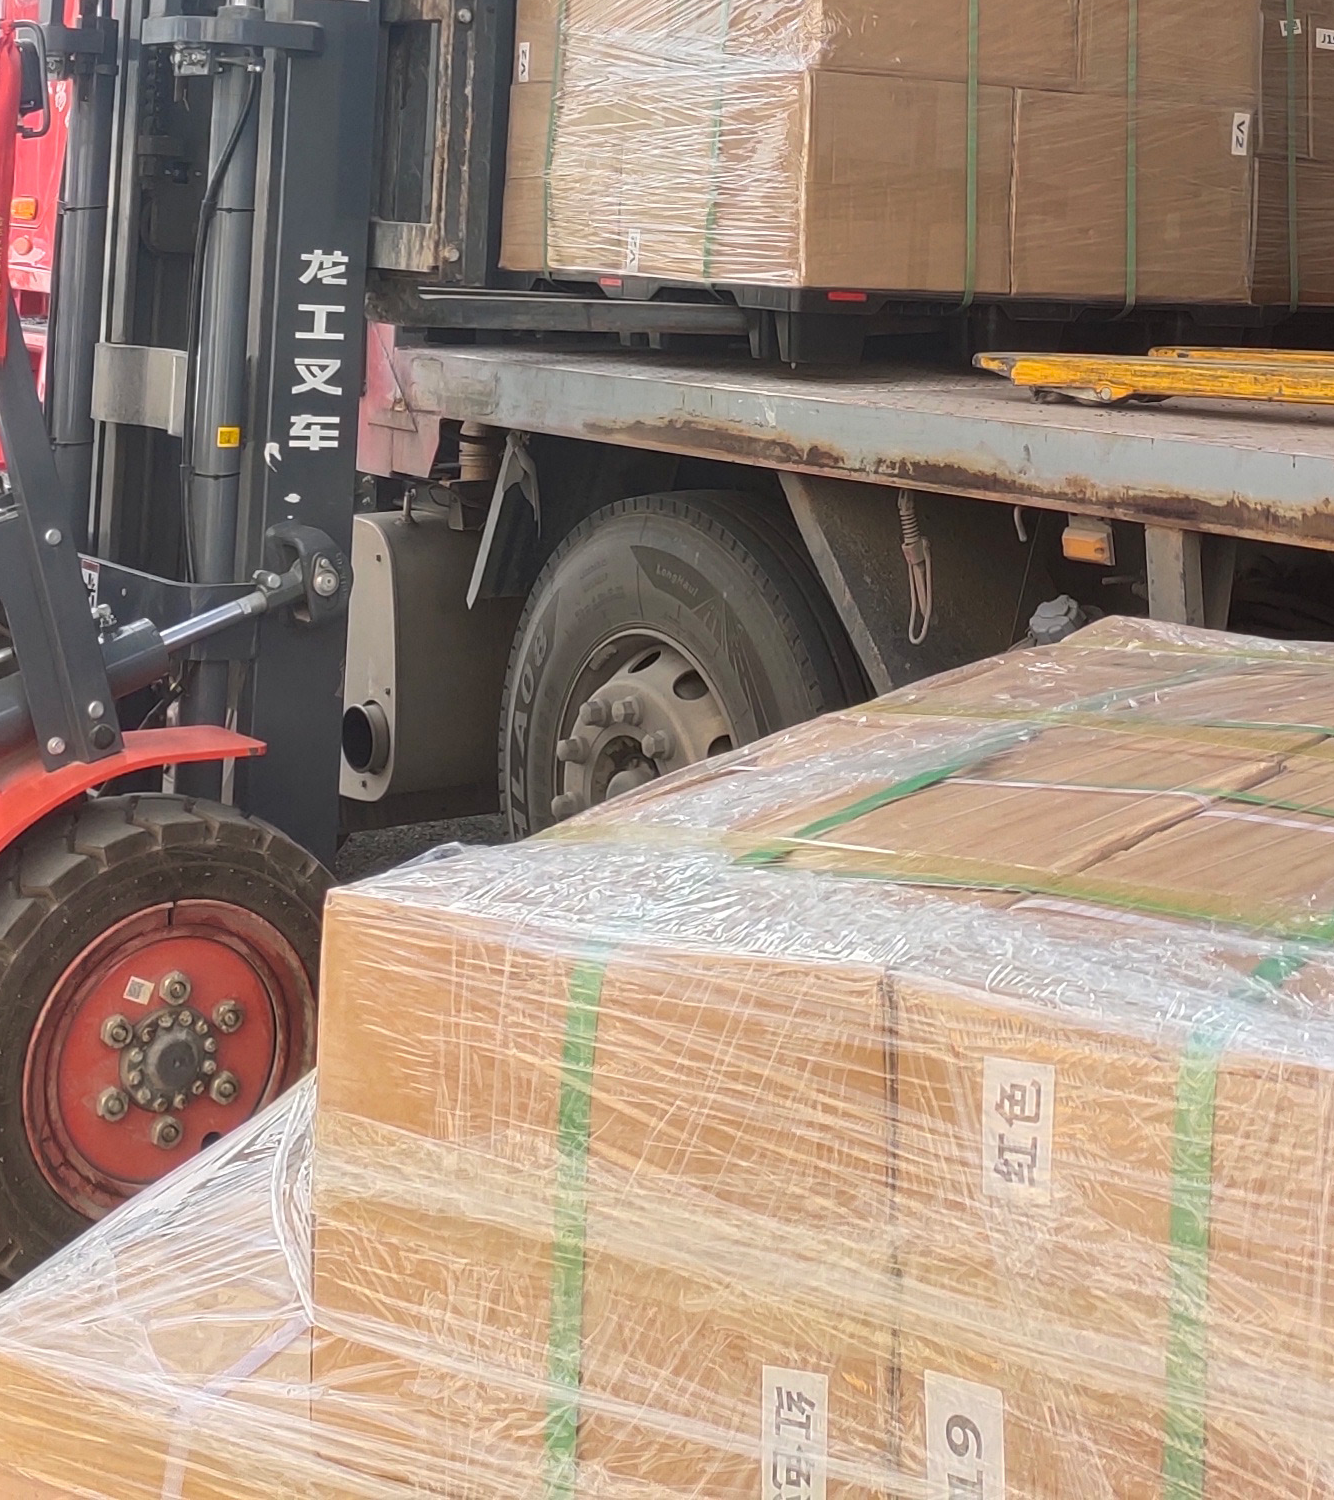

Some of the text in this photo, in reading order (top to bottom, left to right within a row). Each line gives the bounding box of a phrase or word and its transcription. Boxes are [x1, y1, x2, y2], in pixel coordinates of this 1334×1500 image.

[1236, 120, 1245, 149] V2
[288, 249, 349, 451] 龙工叉车
[993, 1077, 1042, 1187] 红色
[771, 1386, 815, 1496] 红色
